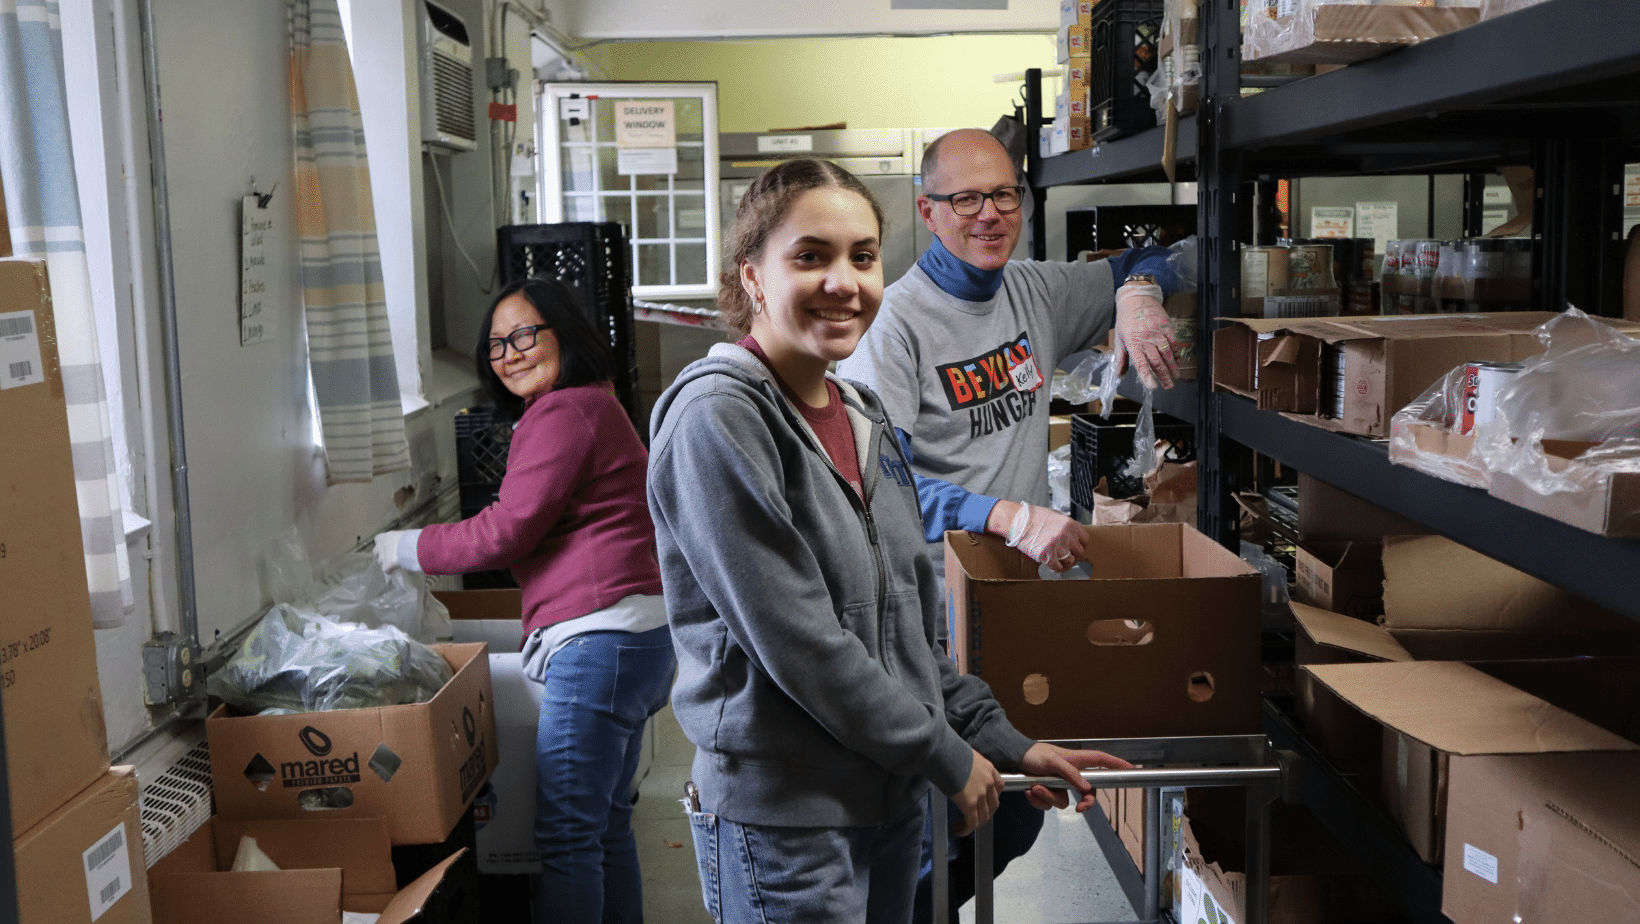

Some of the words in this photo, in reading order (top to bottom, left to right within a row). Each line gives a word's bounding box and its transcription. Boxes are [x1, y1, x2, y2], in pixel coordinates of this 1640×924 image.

[623, 107, 665, 116] DELIVERY
[624, 121, 666, 129] WINDOW
[1015, 363, 1035, 387] Kelly
[281, 752, 360, 779] mared
